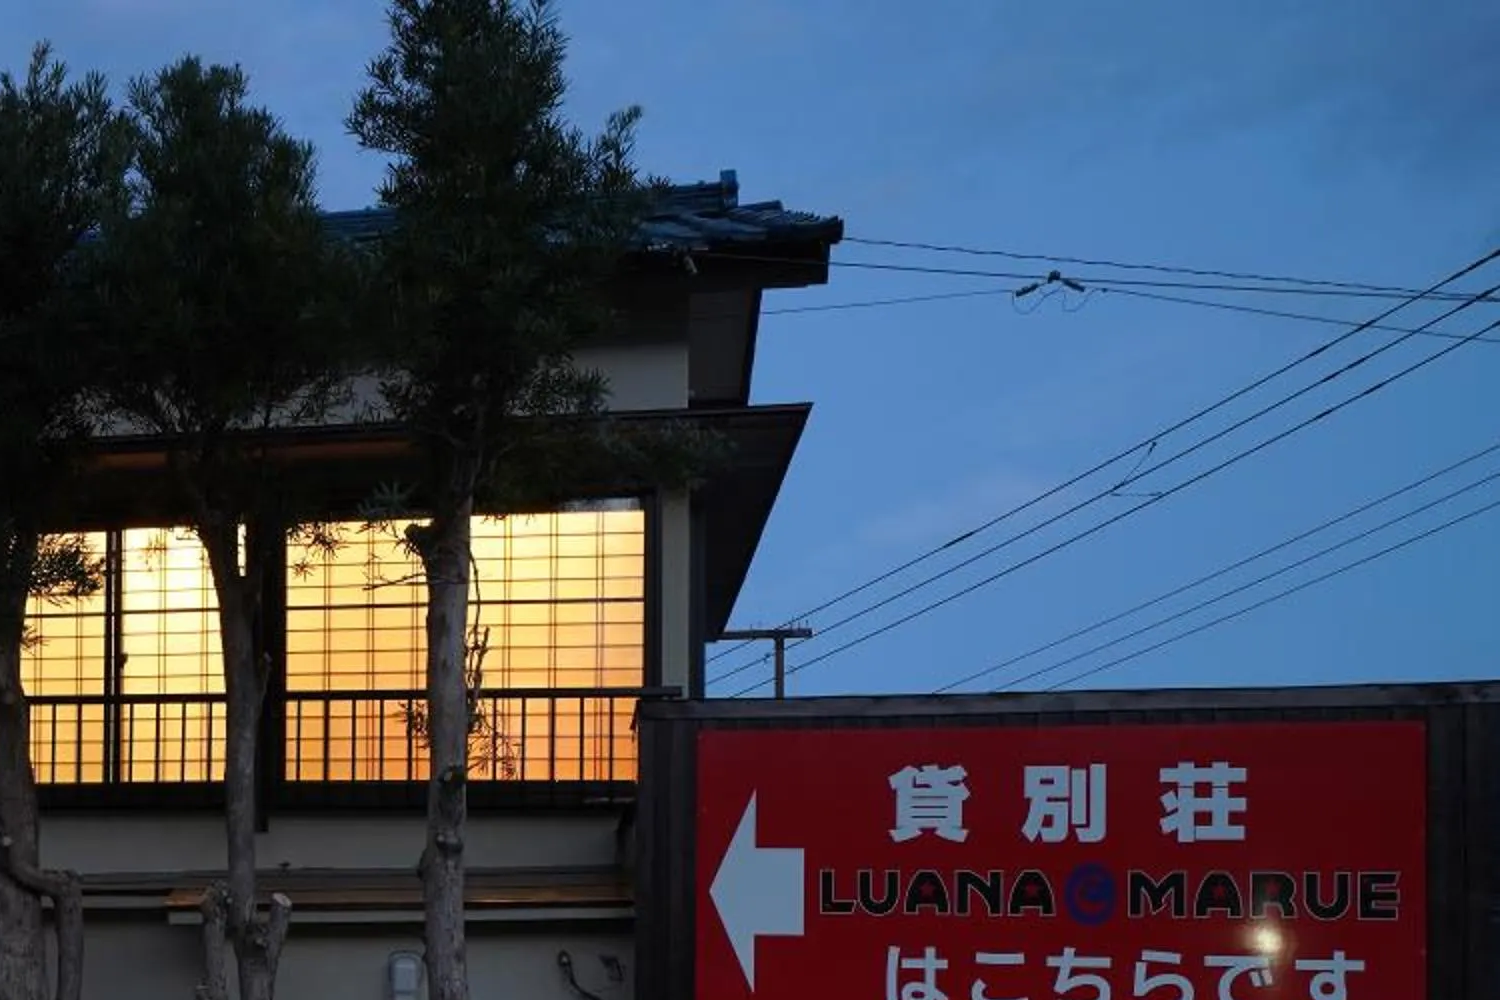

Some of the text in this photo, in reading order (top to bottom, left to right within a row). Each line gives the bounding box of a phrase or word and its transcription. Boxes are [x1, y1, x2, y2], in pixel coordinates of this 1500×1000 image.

[887, 762, 1248, 843] 貸別荘
[819, 868, 1402, 922] LUANA MARUE
